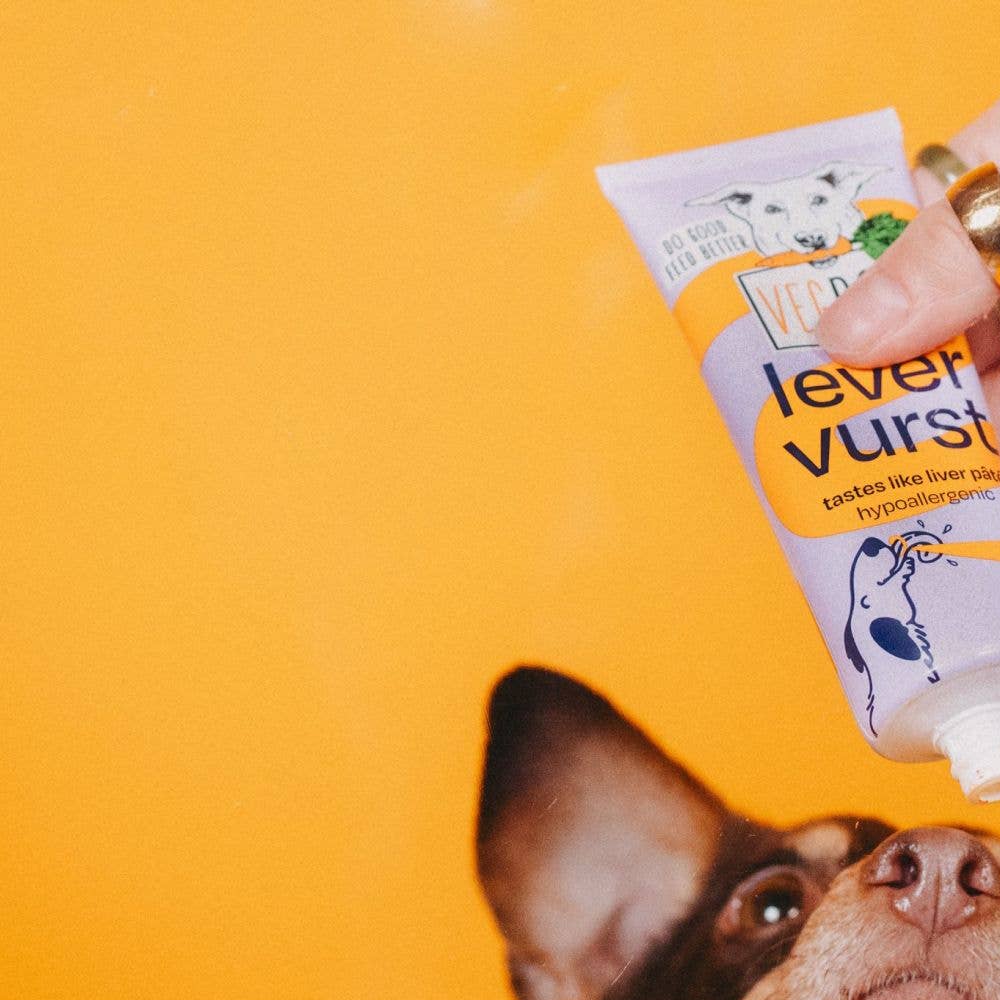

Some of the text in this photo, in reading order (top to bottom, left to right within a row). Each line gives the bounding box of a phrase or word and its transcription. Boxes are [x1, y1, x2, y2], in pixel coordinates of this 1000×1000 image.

[662, 219, 728, 255] DO GOOD
[665, 233, 748, 281] FEED BETTER
[762, 350, 964, 418] lever
[782, 399, 1000, 478] vurst
[822, 480, 887, 512] tastes
[888, 474, 924, 490] like
[925, 468, 966, 483] liver
[857, 486, 997, 521] hypoallergenic
